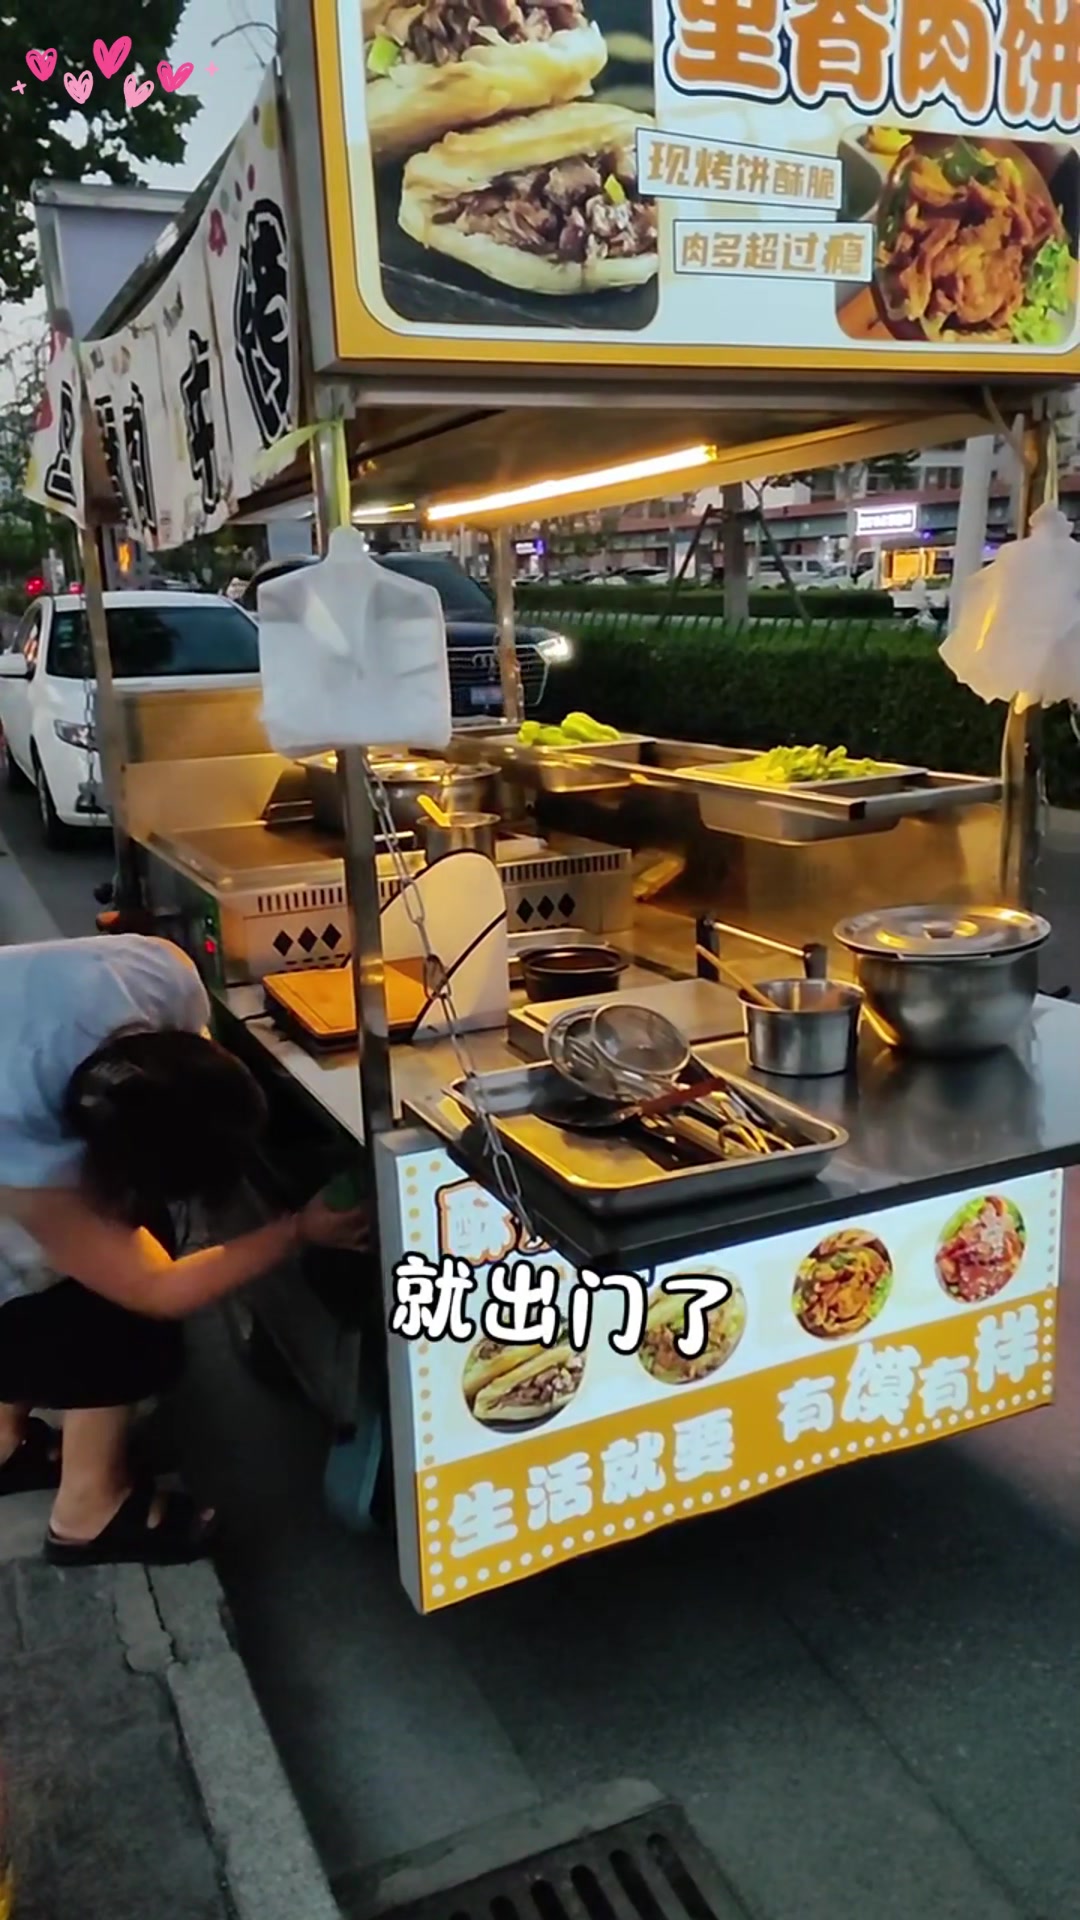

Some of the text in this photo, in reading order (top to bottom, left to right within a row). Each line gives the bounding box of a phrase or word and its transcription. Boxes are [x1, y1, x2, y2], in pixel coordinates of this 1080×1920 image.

[667, 0, 1080, 131] 里脊肉饼
[647, 141, 835, 200] 现烤饼酥脆
[681, 231, 866, 275] 肉多超过瘾
[449, 1303, 1040, 1558] 生活就要 有馍有样
